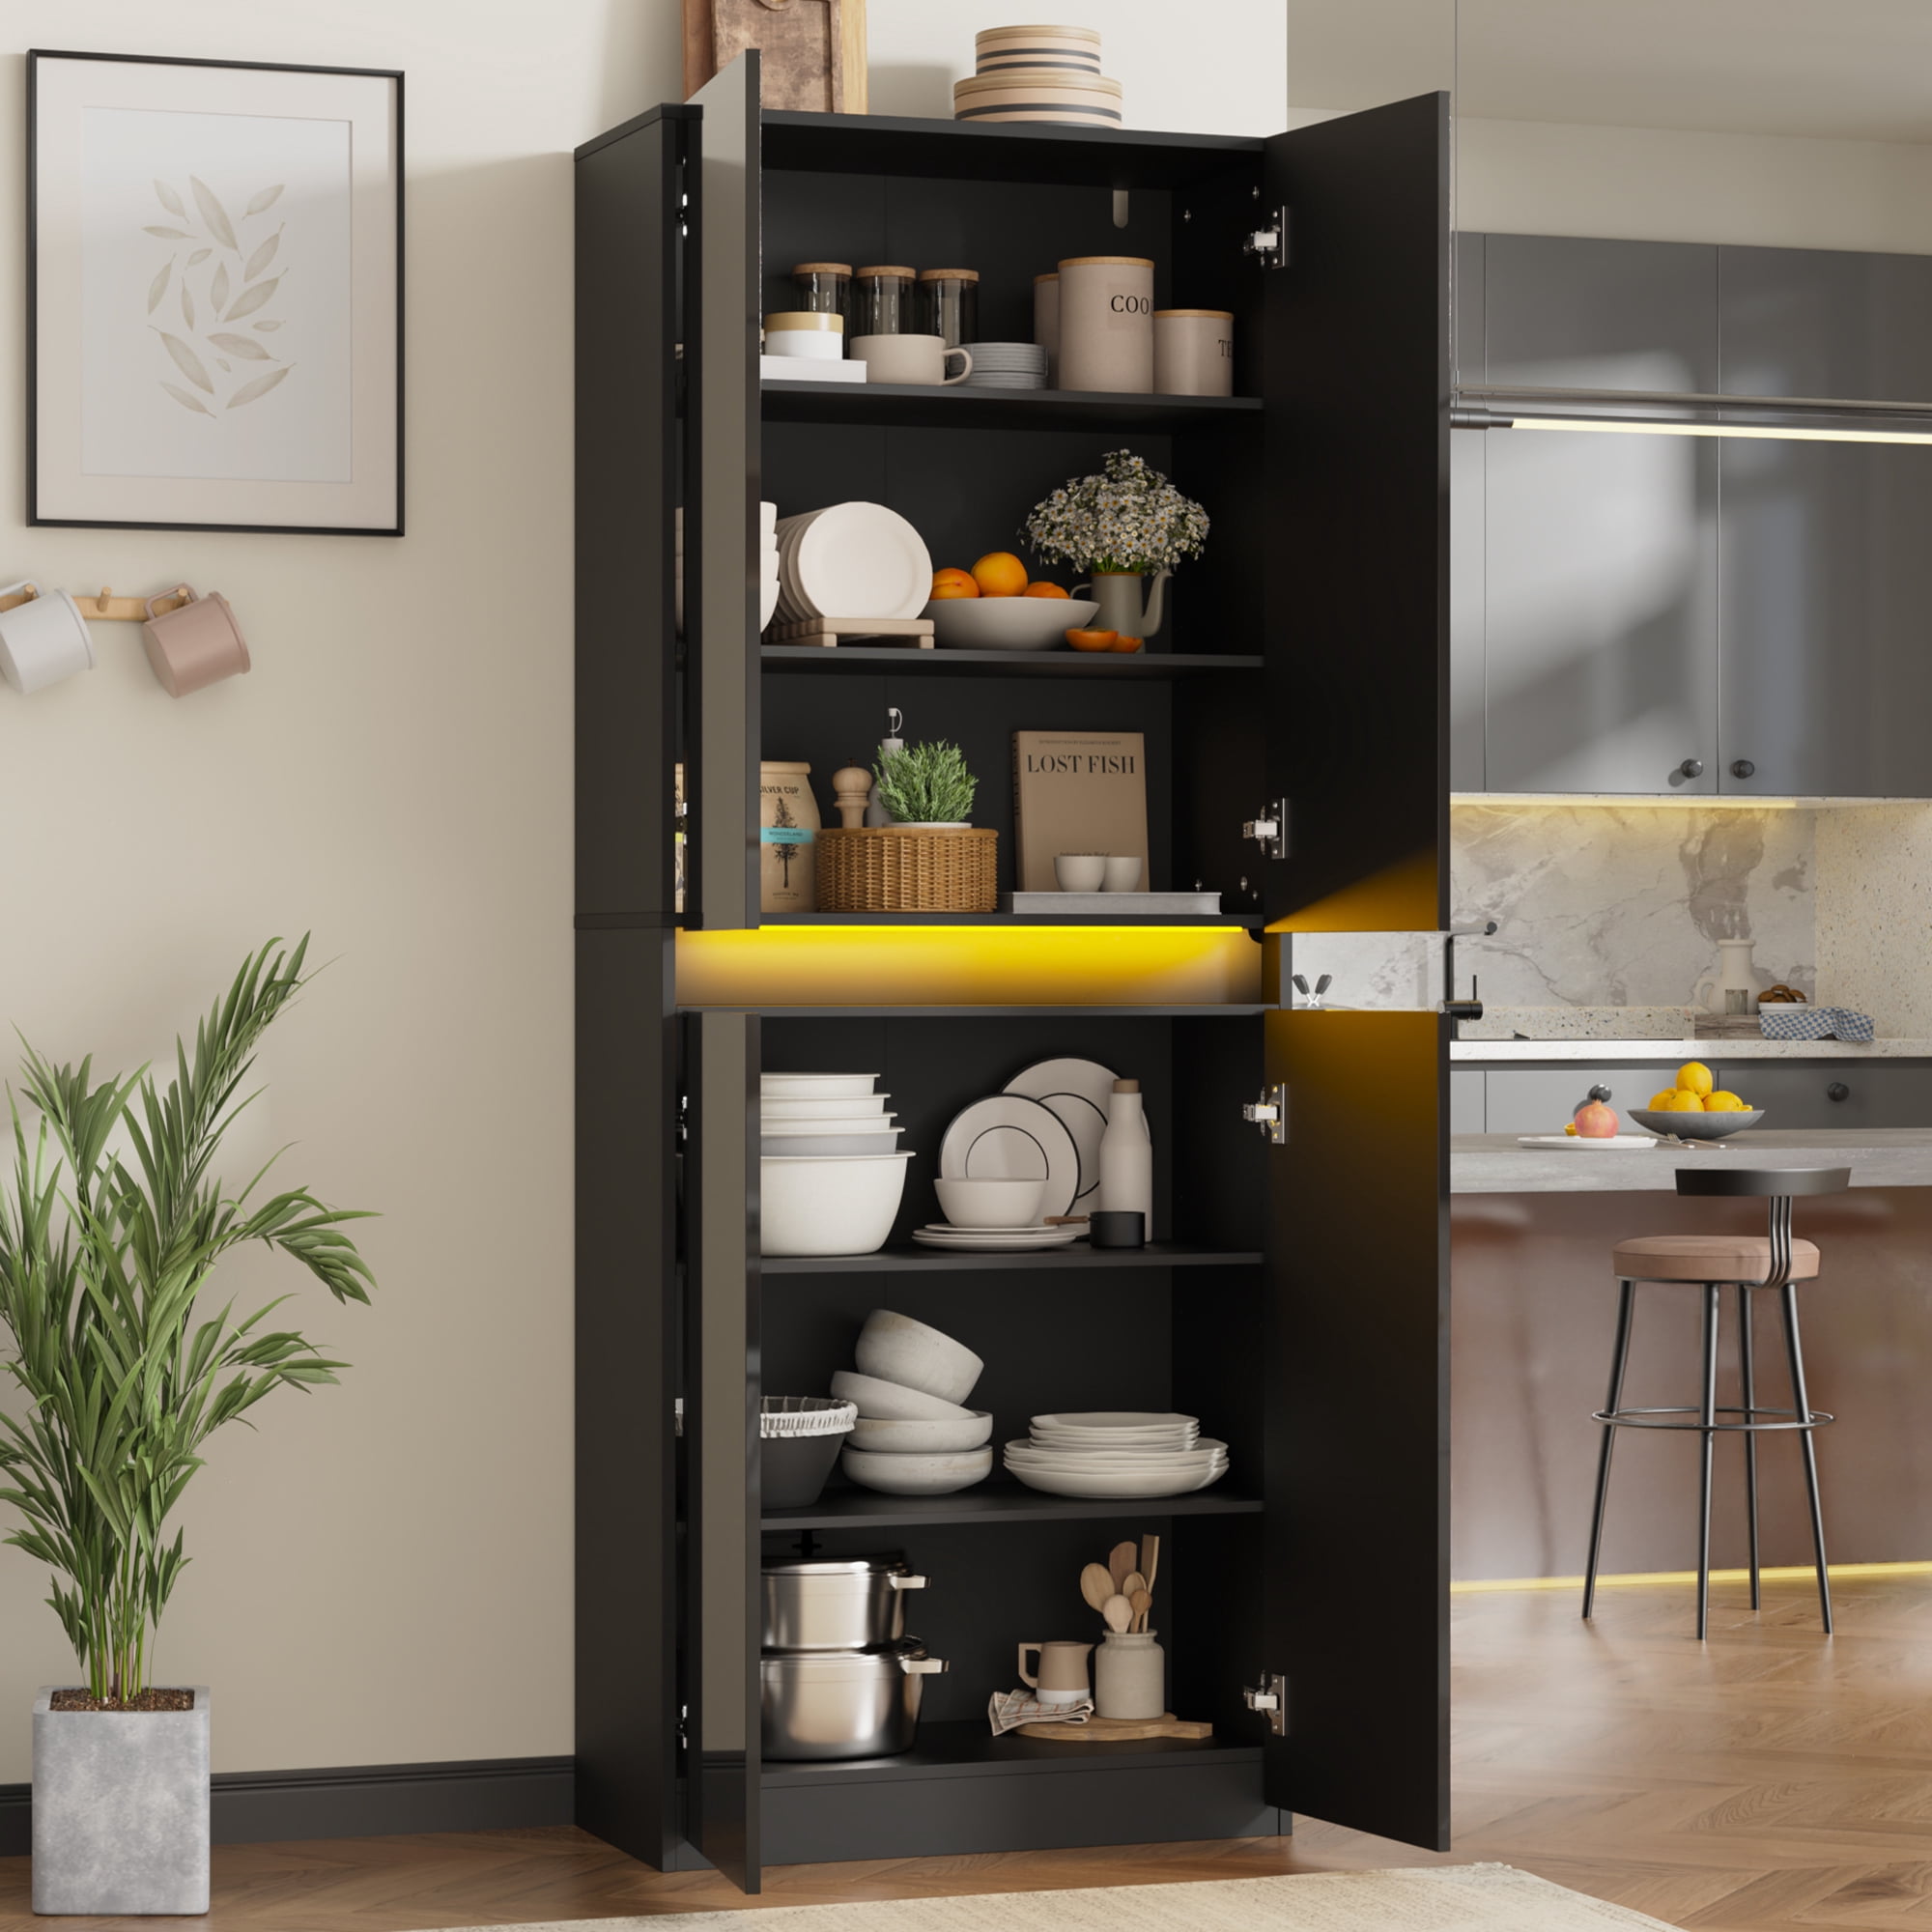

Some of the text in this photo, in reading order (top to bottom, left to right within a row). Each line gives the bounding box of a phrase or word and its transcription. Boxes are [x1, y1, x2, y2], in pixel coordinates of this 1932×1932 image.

[1111, 295, 1153, 316] COO
[1027, 753, 1135, 775] LOST FISH
[783, 786, 800, 795] CUP
